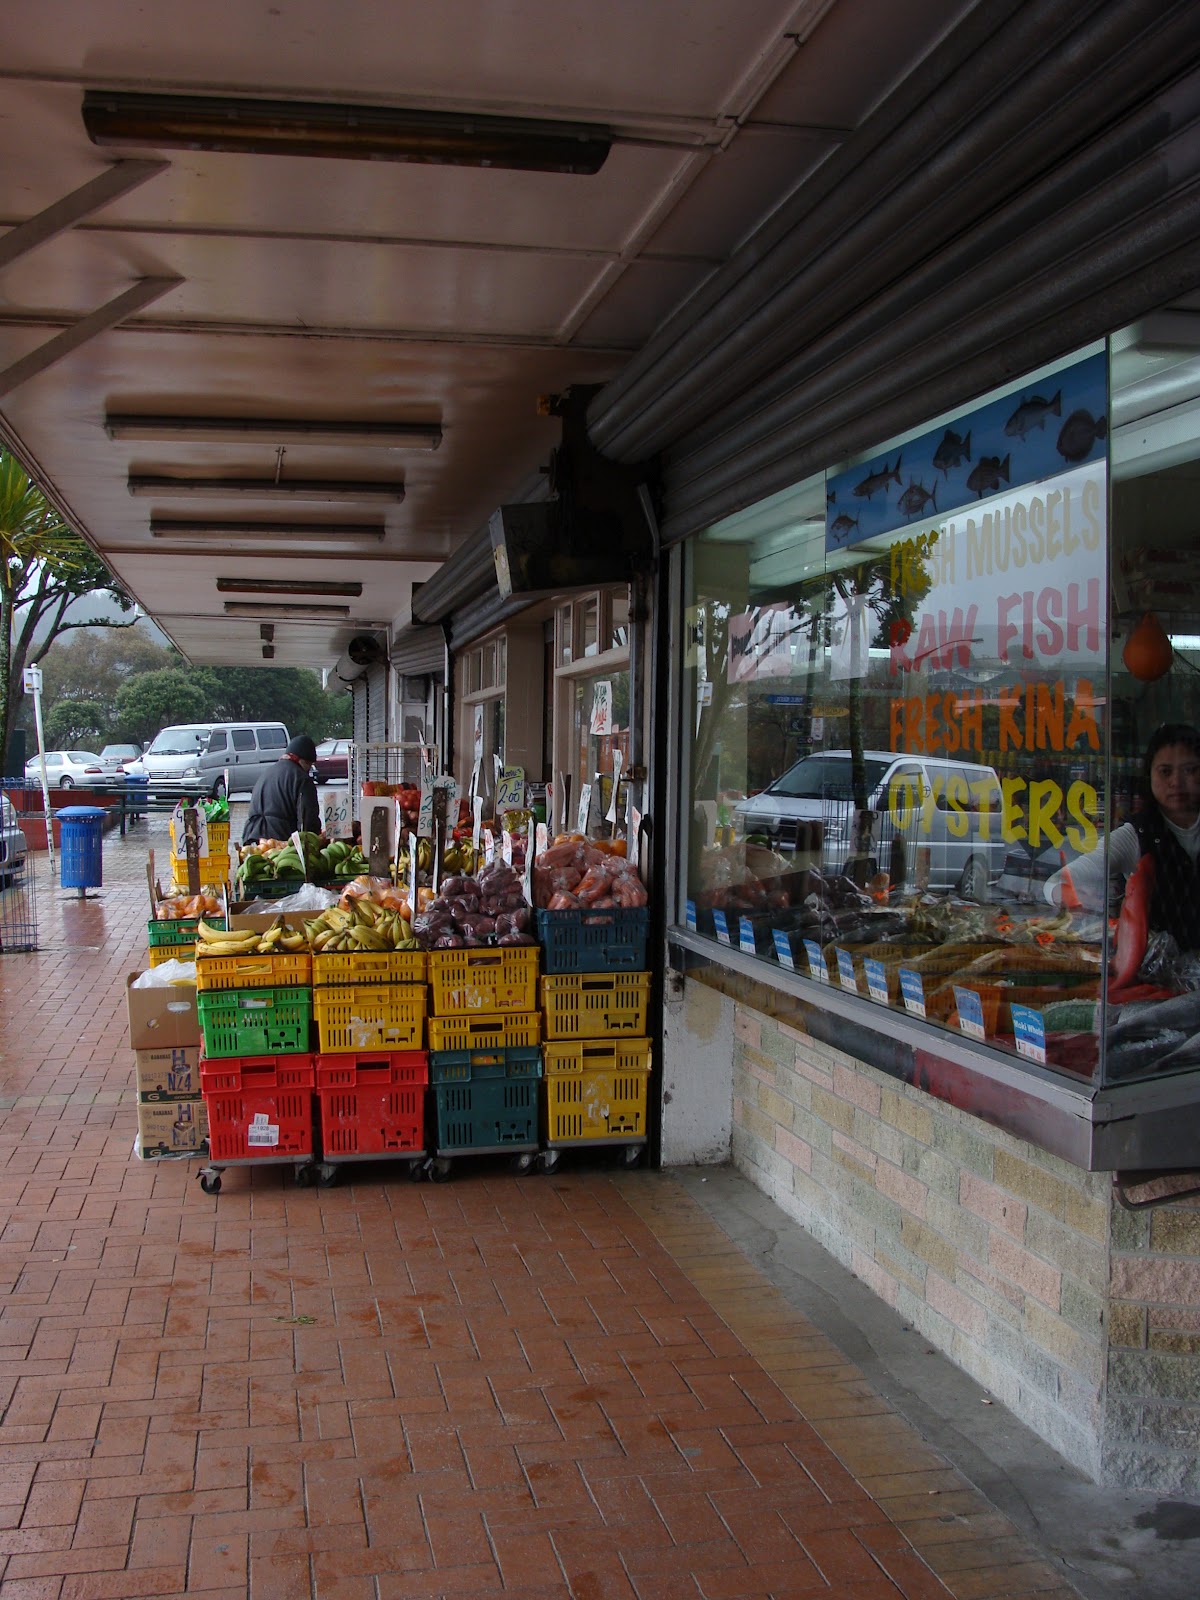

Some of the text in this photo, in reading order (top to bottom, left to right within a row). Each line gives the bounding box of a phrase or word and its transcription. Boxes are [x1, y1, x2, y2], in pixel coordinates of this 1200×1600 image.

[967, 479, 1100, 582] MUSSELS
[889, 577, 1101, 678] RAW FISH
[888, 677, 1101, 755] FRESH KINA
[887, 772, 1100, 855] OYSTERS
[1027, 1023, 1044, 1037] Whole
